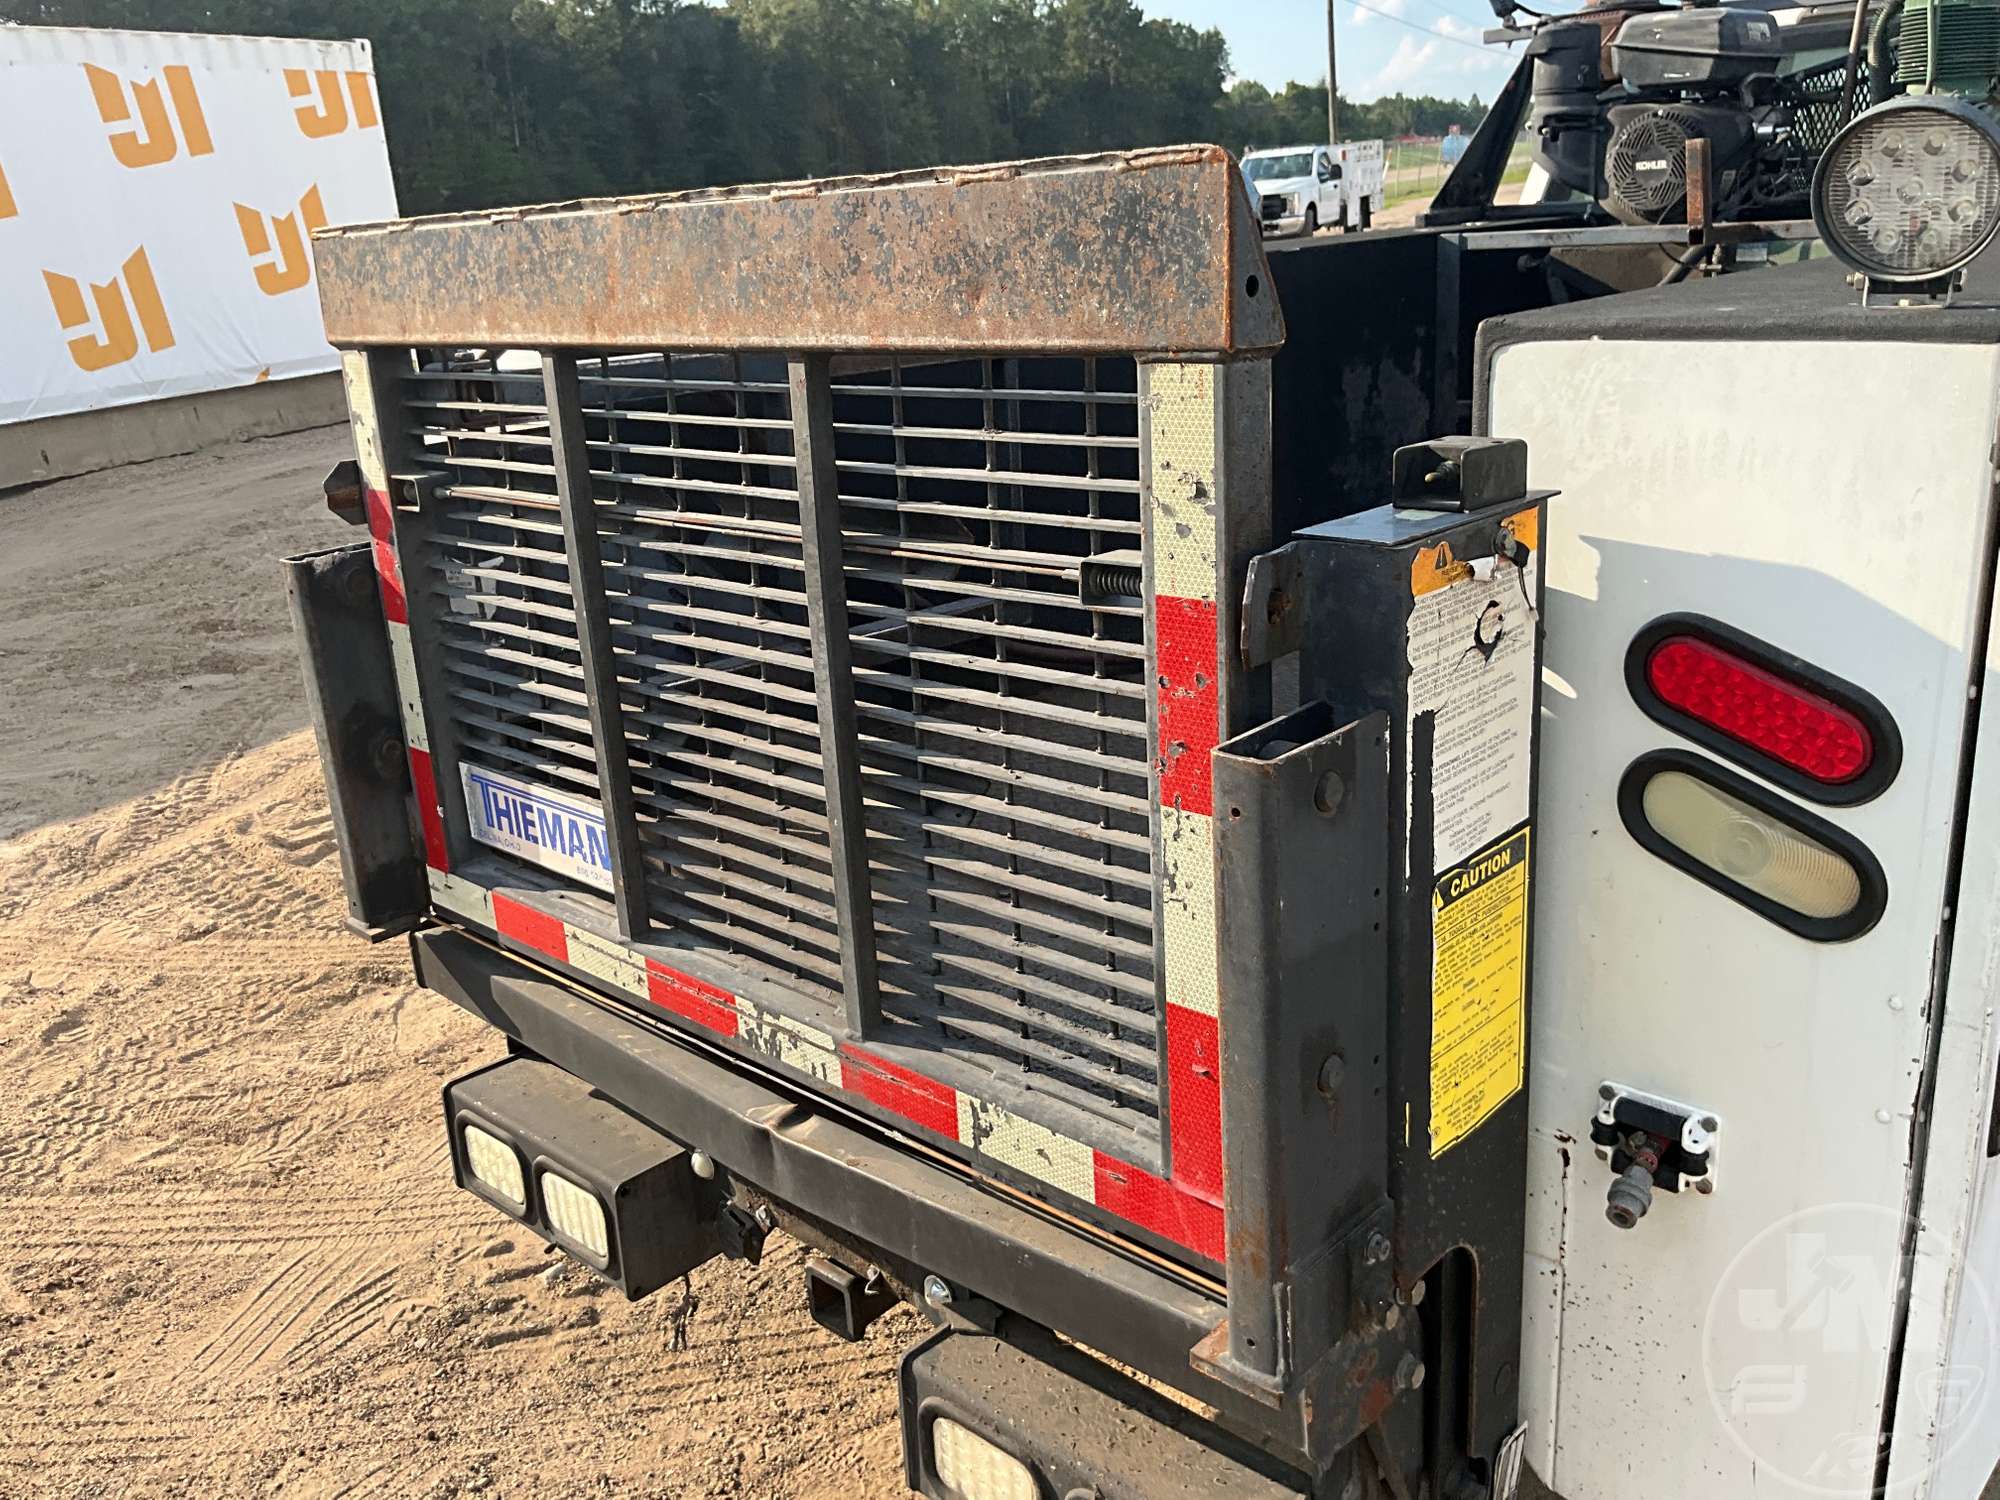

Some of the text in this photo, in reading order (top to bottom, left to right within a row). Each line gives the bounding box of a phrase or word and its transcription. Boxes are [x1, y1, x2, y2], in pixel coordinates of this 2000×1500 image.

[1636, 160, 1667, 170] KOHLER
[471, 774, 612, 872] THIEMAN
[1450, 849, 1511, 897] CAUTION
